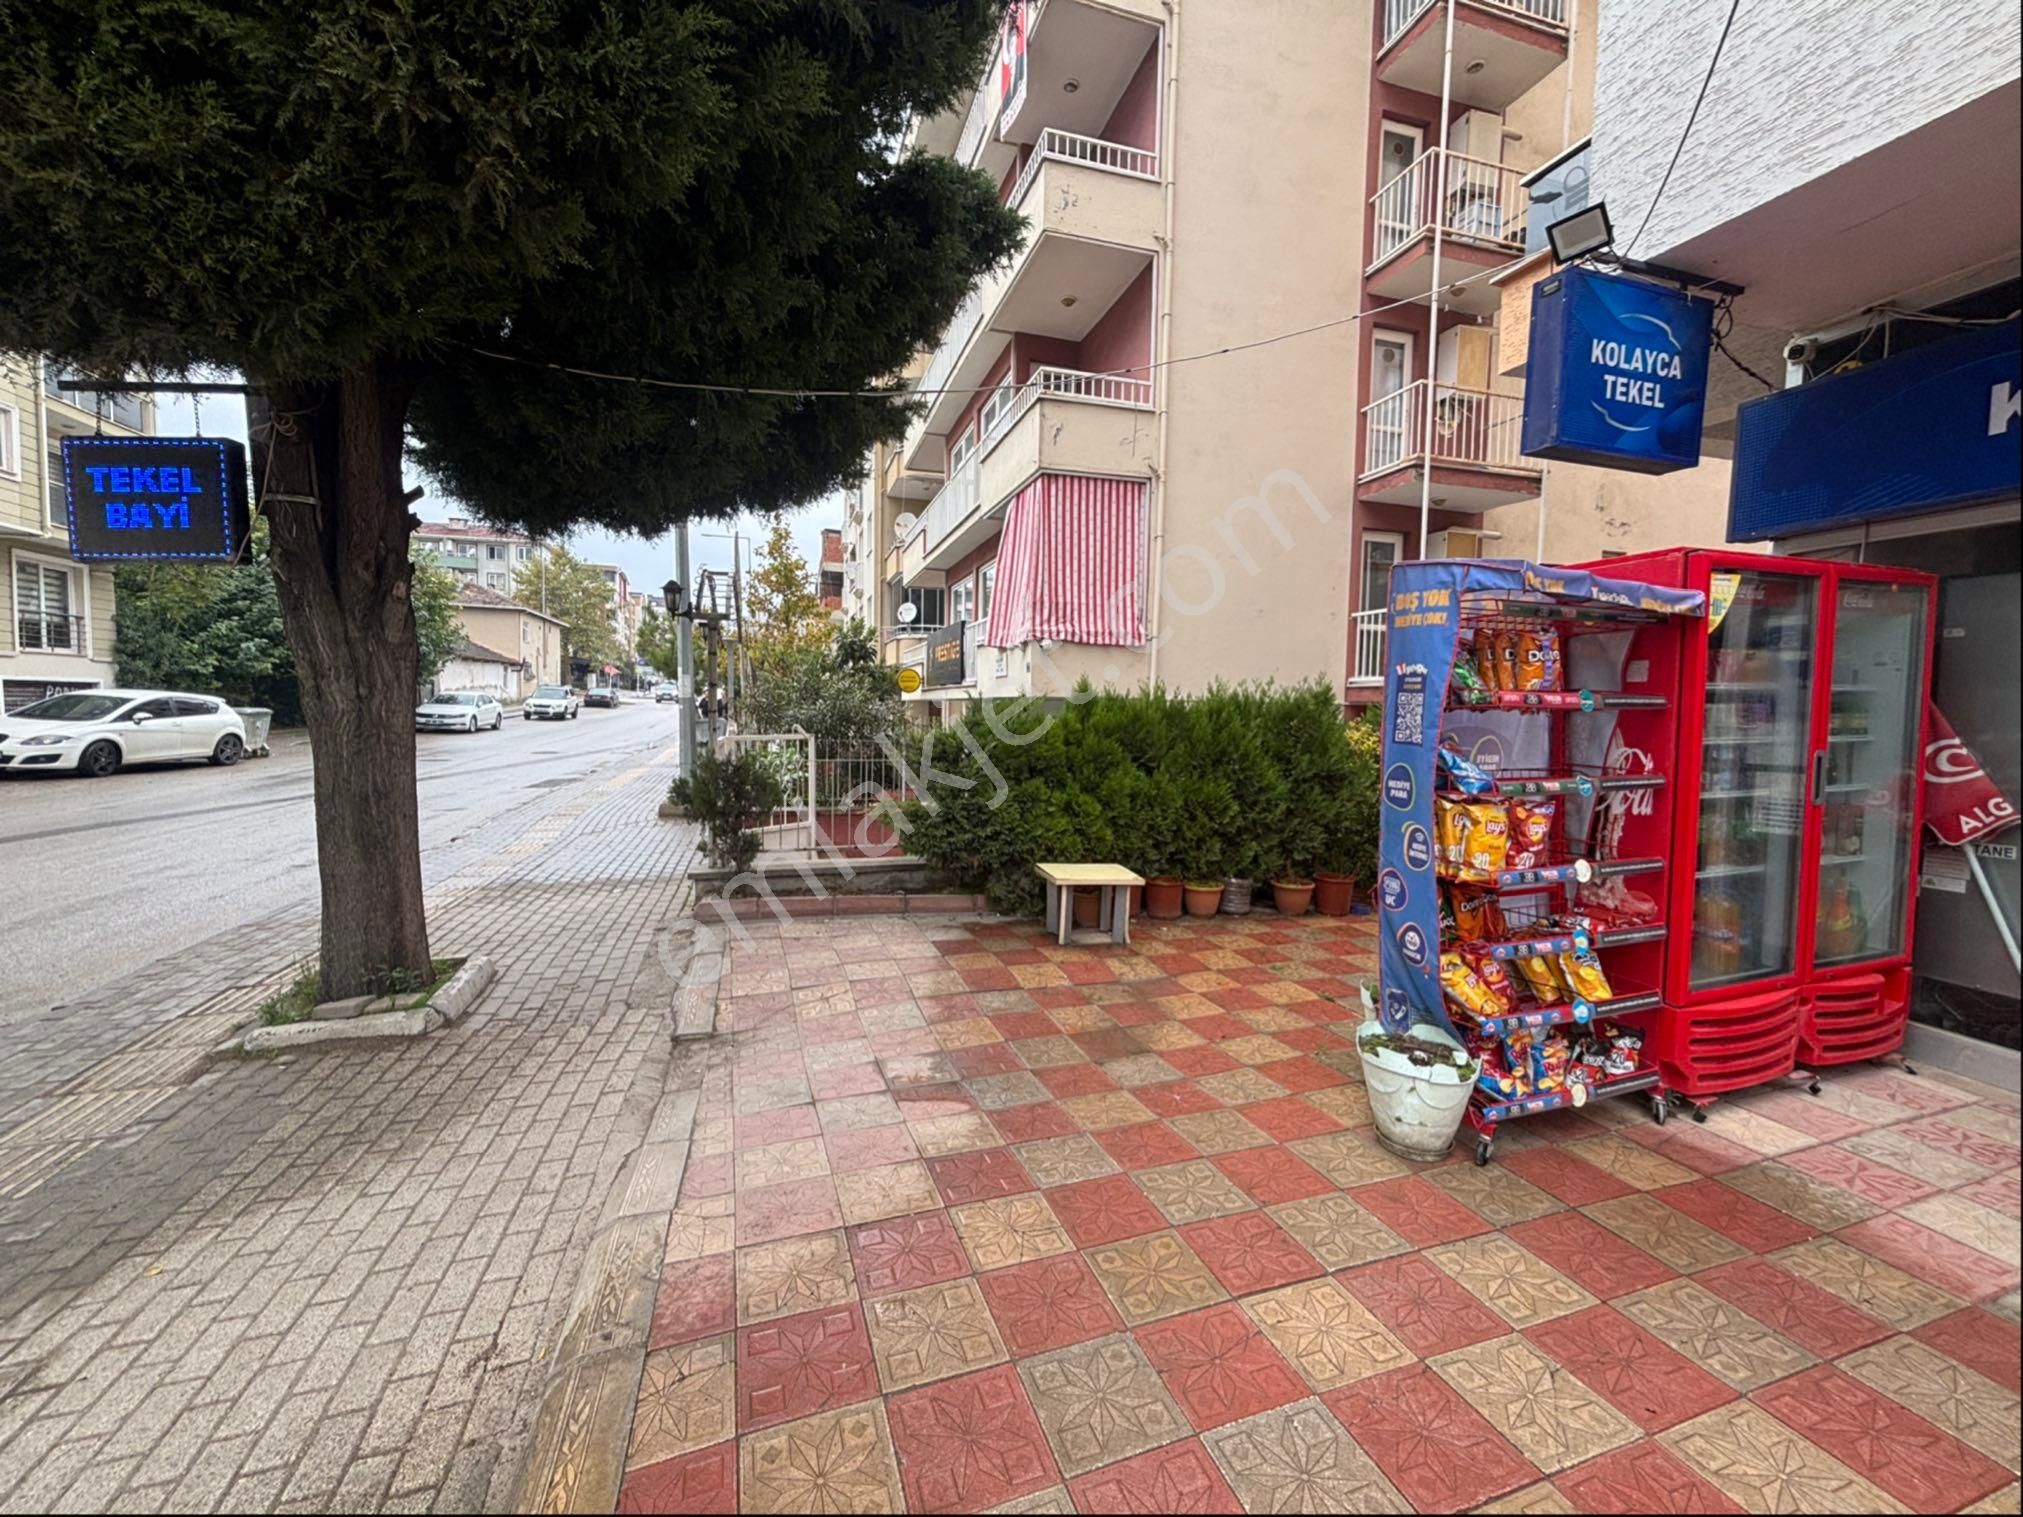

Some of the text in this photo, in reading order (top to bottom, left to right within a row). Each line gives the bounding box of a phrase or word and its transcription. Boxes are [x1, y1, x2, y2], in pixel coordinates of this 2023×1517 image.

[1590, 338, 1682, 380] KOLAYCA
[1603, 374, 1665, 409] TEKEL
[86, 466, 202, 494] TEKEL
[105, 496, 190, 529] BAYİ
